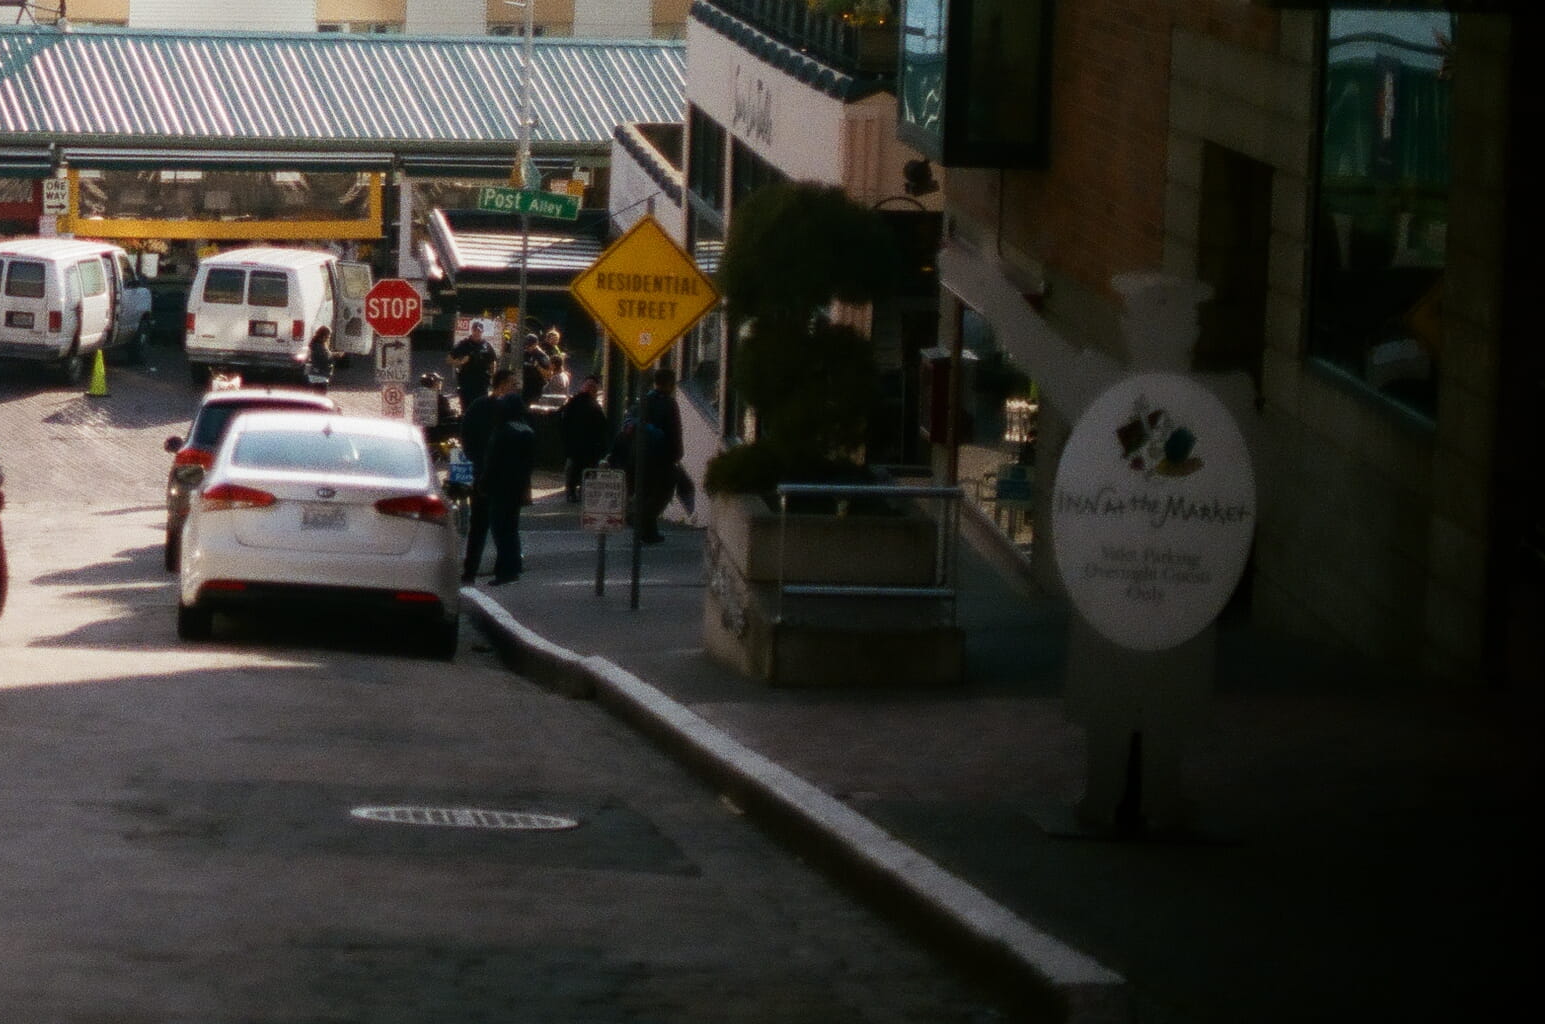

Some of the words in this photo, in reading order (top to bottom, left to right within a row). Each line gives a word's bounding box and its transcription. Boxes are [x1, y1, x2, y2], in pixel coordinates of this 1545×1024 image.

[45, 191, 67, 200] WAY
[46, 181, 67, 191] ONE
[484, 188, 521, 210] Post
[528, 199, 563, 217] Alley
[597, 273, 700, 296] RESIDENTIAL
[368, 297, 418, 319] STOP
[617, 299, 678, 320] STREET
